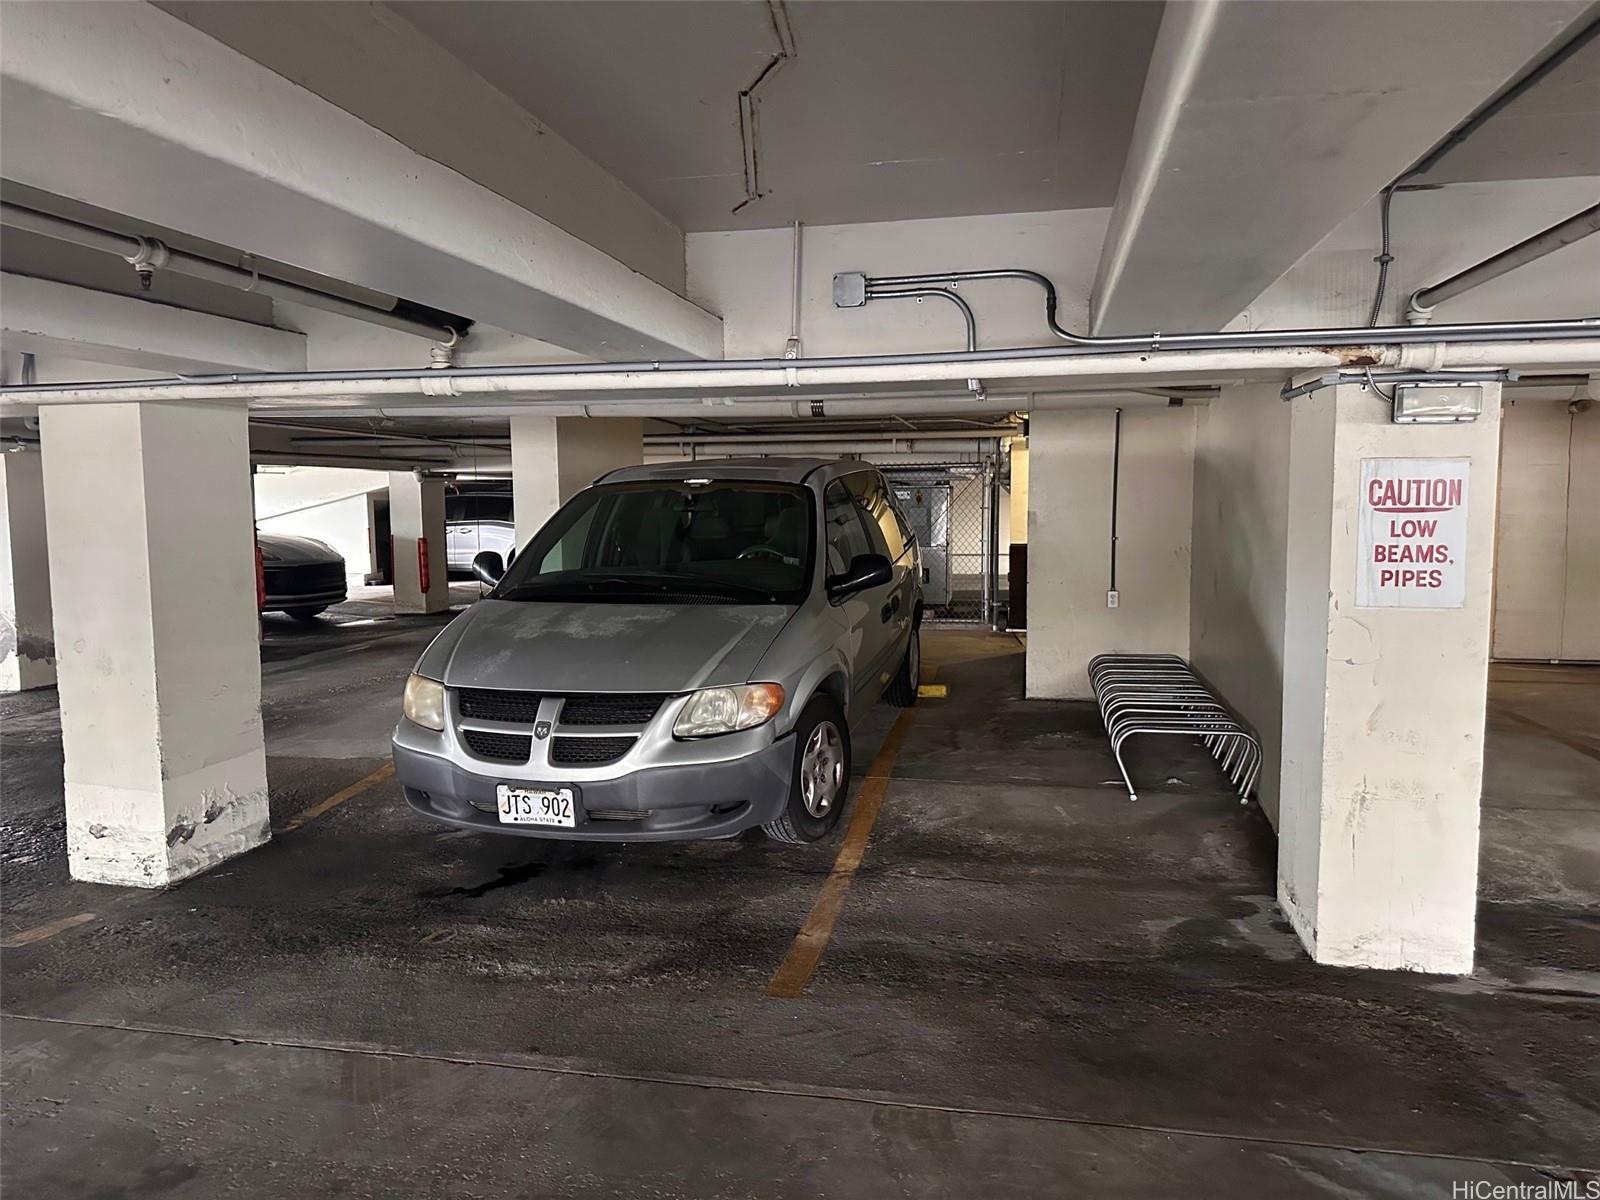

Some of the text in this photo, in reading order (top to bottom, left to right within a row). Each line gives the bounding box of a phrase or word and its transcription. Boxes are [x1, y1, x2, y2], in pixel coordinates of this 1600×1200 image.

[1368, 478, 1462, 507] CAUTION
[1390, 520, 1438, 538] LOW
[1380, 569, 1443, 588] PIPES
[502, 794, 571, 818] JTS 902
